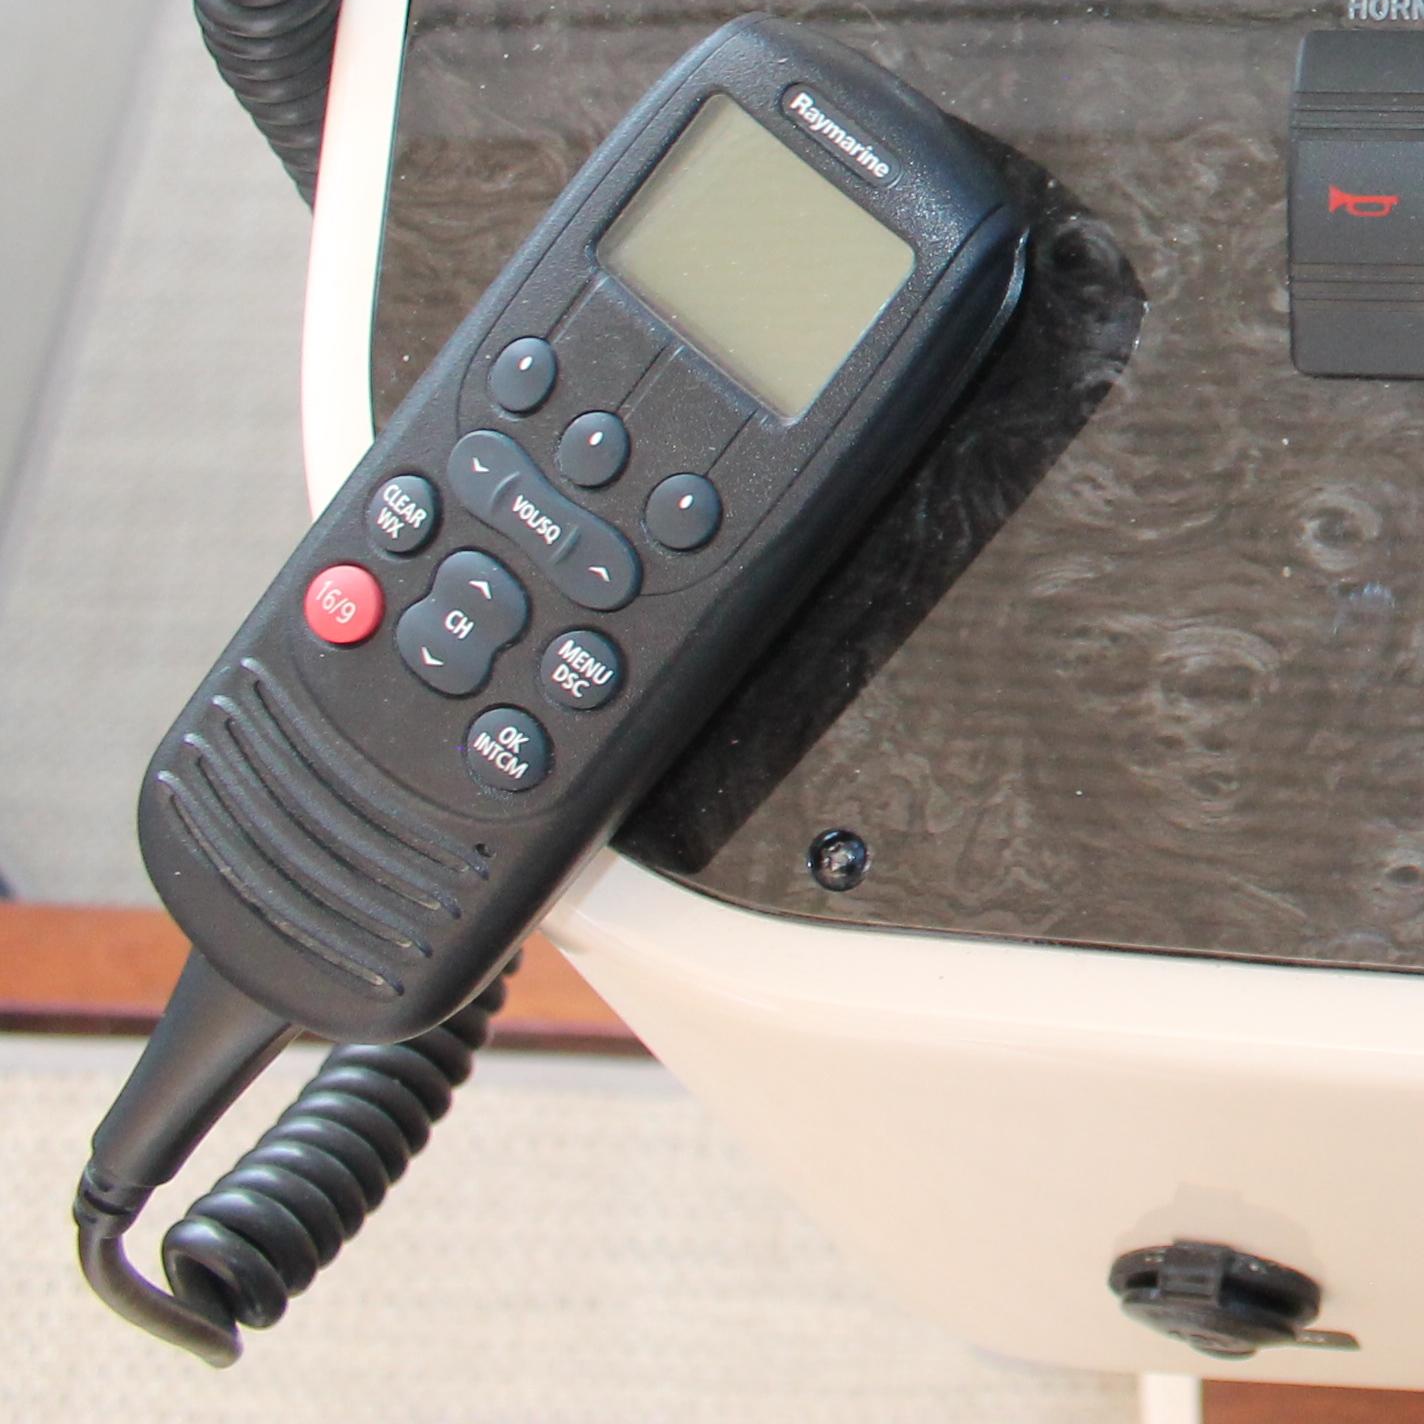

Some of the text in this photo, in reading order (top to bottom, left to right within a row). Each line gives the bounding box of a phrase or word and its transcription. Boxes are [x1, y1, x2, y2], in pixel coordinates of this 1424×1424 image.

[790, 92, 890, 178] Raymarine
[376, 507, 405, 539] WX
[382, 484, 427, 528] CLEAR
[512, 495, 561, 544] VOL/SQ
[315, 579, 357, 624] 16/9
[444, 610, 475, 639] CH
[551, 664, 590, 698] DSC
[557, 640, 614, 685] MENU
[474, 731, 529, 779] INTCM
[498, 726, 529, 754] OK
